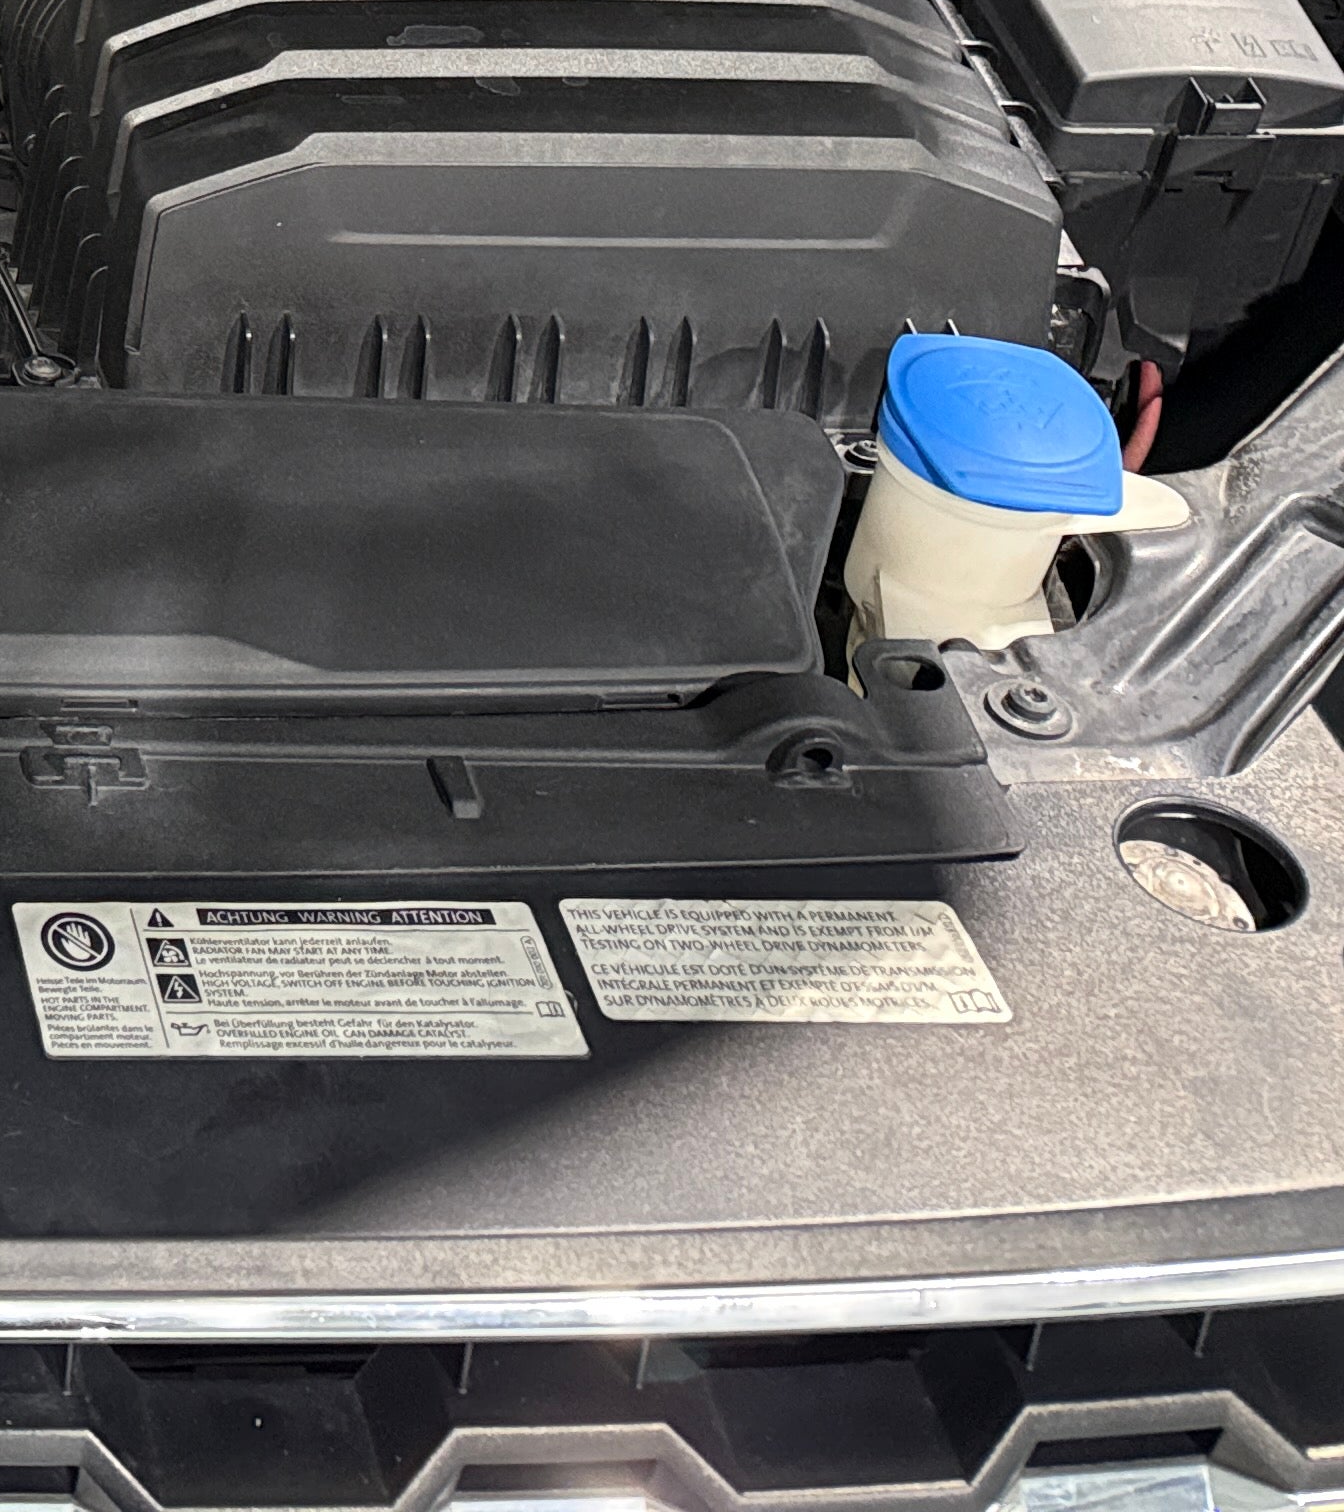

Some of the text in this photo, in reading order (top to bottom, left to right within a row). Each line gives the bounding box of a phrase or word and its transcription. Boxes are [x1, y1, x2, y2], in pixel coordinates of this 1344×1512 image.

[206, 910, 483, 924] ACHTUNG WARNING ATTENTION
[567, 909, 896, 923] THIS VEHICLE IS EQUIPPED WITH A PERMANENT
[655, 924, 699, 935] DRIVE
[700, 924, 756, 936] SYSTEM
[757, 925, 790, 936] AND
[793, 925, 807, 936] IS
[808, 925, 863, 937] EXEMPT
[865, 925, 906, 937] FROM
[580, 938, 641, 950] TESTING
[643, 939, 667, 950] ON
[762, 940, 806, 951] DRIVE
[193, 947, 243, 955] RADIATOR
[245, 947, 265, 955] FAN
[268, 947, 291, 955] MAY
[293, 947, 324, 955] START
[326, 947, 338, 955] AT
[341, 947, 362, 955] ANY
[590, 964, 608, 975] CE
[610, 962, 680, 976] VÉHICULE
[682, 964, 705, 975] EST
[708, 963, 746, 976] DOTÉ
[849, 965, 871, 976] DE
[202, 979, 229, 988] HIGH
[281, 979, 322, 988] SWITCH
[324, 979, 343, 988] OFF
[346, 979, 384, 988] ENGINE
[387, 979, 425, 988] BEFORE
[428, 979, 485, 988] TOUCHING
[487, 978, 535, 988] IGNITION
[673, 979, 756, 991] PERMANENT
[758, 979, 776, 991] ET
[604, 994, 633, 1006] SUR
[216, 1029, 277, 1038] OVERFILLED
[279, 1029, 320, 1038] ENGINE
[322, 1029, 339, 1038] OIL
[343, 1029, 366, 1038] CAN
[368, 1029, 416, 1038] DAMAGE
